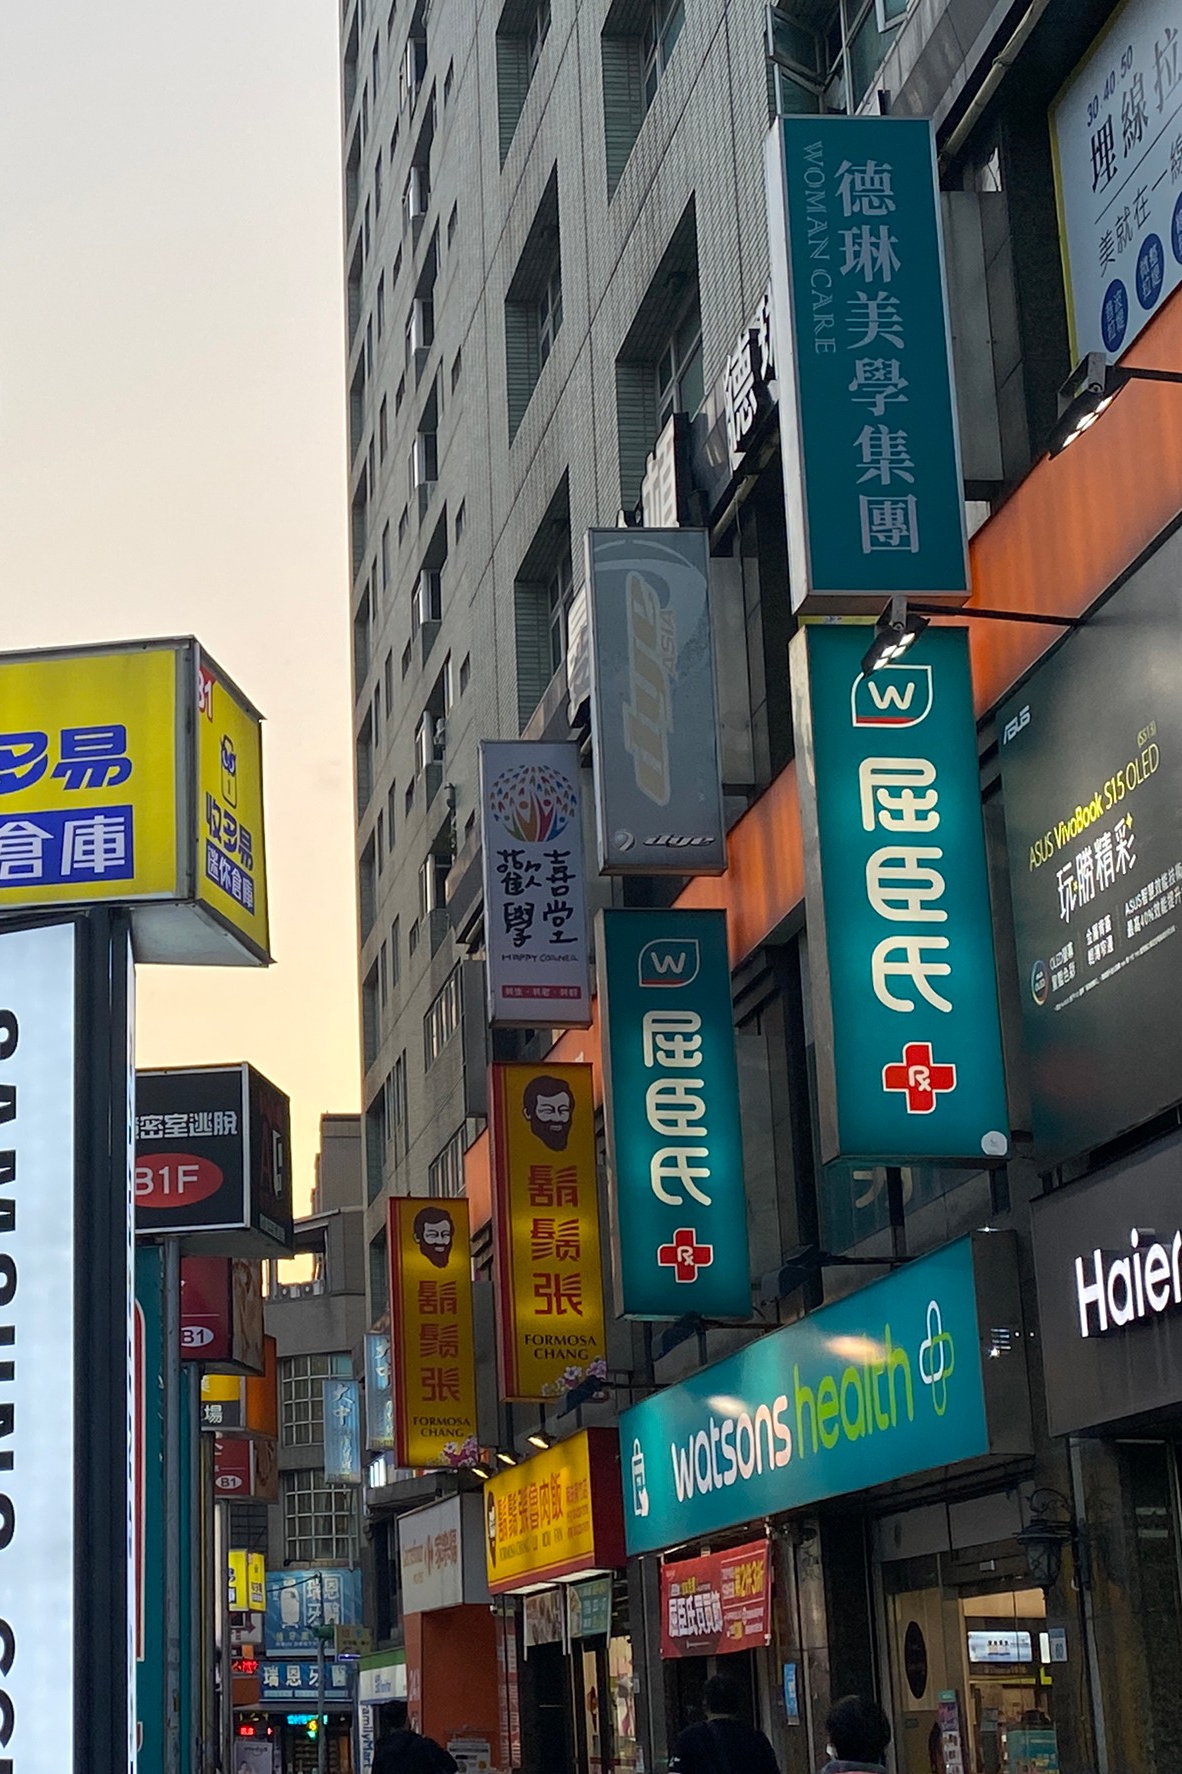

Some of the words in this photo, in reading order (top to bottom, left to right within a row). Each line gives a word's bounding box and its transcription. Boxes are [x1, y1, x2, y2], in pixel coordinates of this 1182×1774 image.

[803, 140, 831, 261] WOMAN
[810, 266, 836, 355] CARE
[834, 159, 920, 555] 德琳美學集團
[1002, 704, 1032, 745] ASUS
[205, 791, 254, 873] 收多易
[1029, 831, 1055, 872] ASUS
[1053, 791, 1103, 848] VivoBook
[1104, 770, 1126, 810] S15
[1126, 743, 1160, 791] OLED
[206, 845, 255, 909] 迷你倉庫
[496, 849, 576, 897] 歡喜
[858, 756, 952, 1013] 屈臣氏
[1055, 818, 1138, 924] 玩勝精彩
[501, 953, 537, 962] HAPPY
[503, 900, 579, 948] 學堂
[642, 1010, 712, 1206] 屈臣氏
[528, 1164, 583, 1317] 鬍鬚張
[1075, 1227, 1182, 1338] Haier
[181, 1329, 205, 1345] B1
[417, 1279, 461, 1402] 鬍鬚張
[524, 1333, 597, 1348] FORMOSA
[533, 1347, 589, 1361] CHANG
[413, 1416, 470, 1427] FORMOSA
[420, 1427, 465, 1438] CHANG
[670, 1394, 793, 1503] watsons
[792, 1322, 915, 1460] health
[220, 1477, 238, 1488] B1
